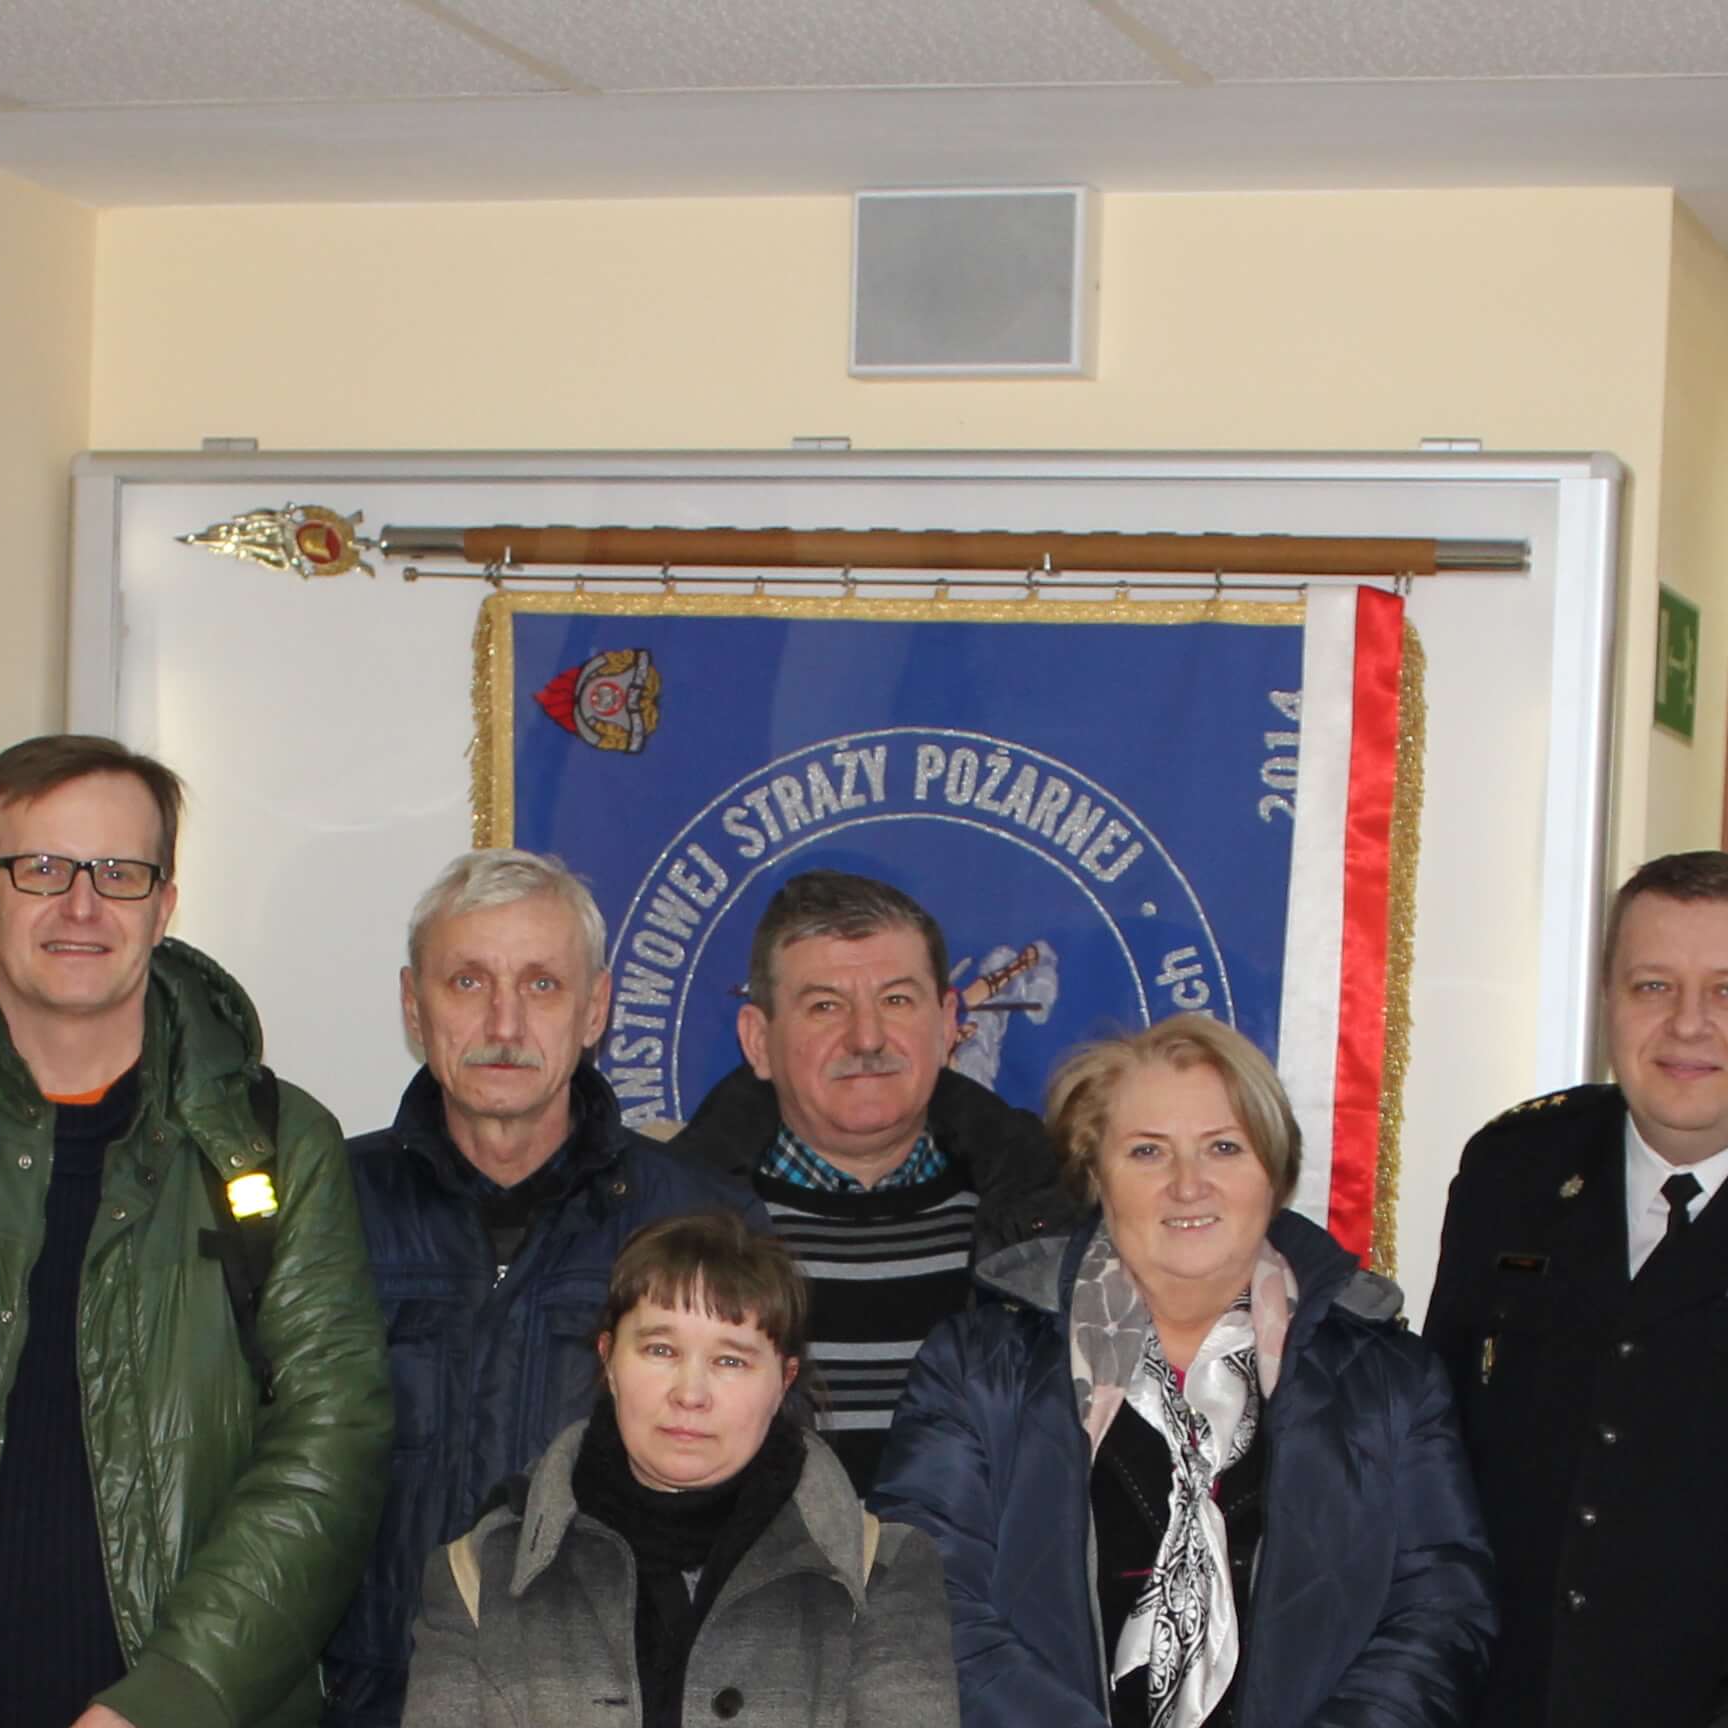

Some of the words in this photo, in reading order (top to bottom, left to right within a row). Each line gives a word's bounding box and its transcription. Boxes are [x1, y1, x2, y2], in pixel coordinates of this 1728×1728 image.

[721, 740, 888, 860] STRAŻY
[914, 744, 1145, 882] POŻARNEJ
[1259, 690, 1303, 823] 2014
